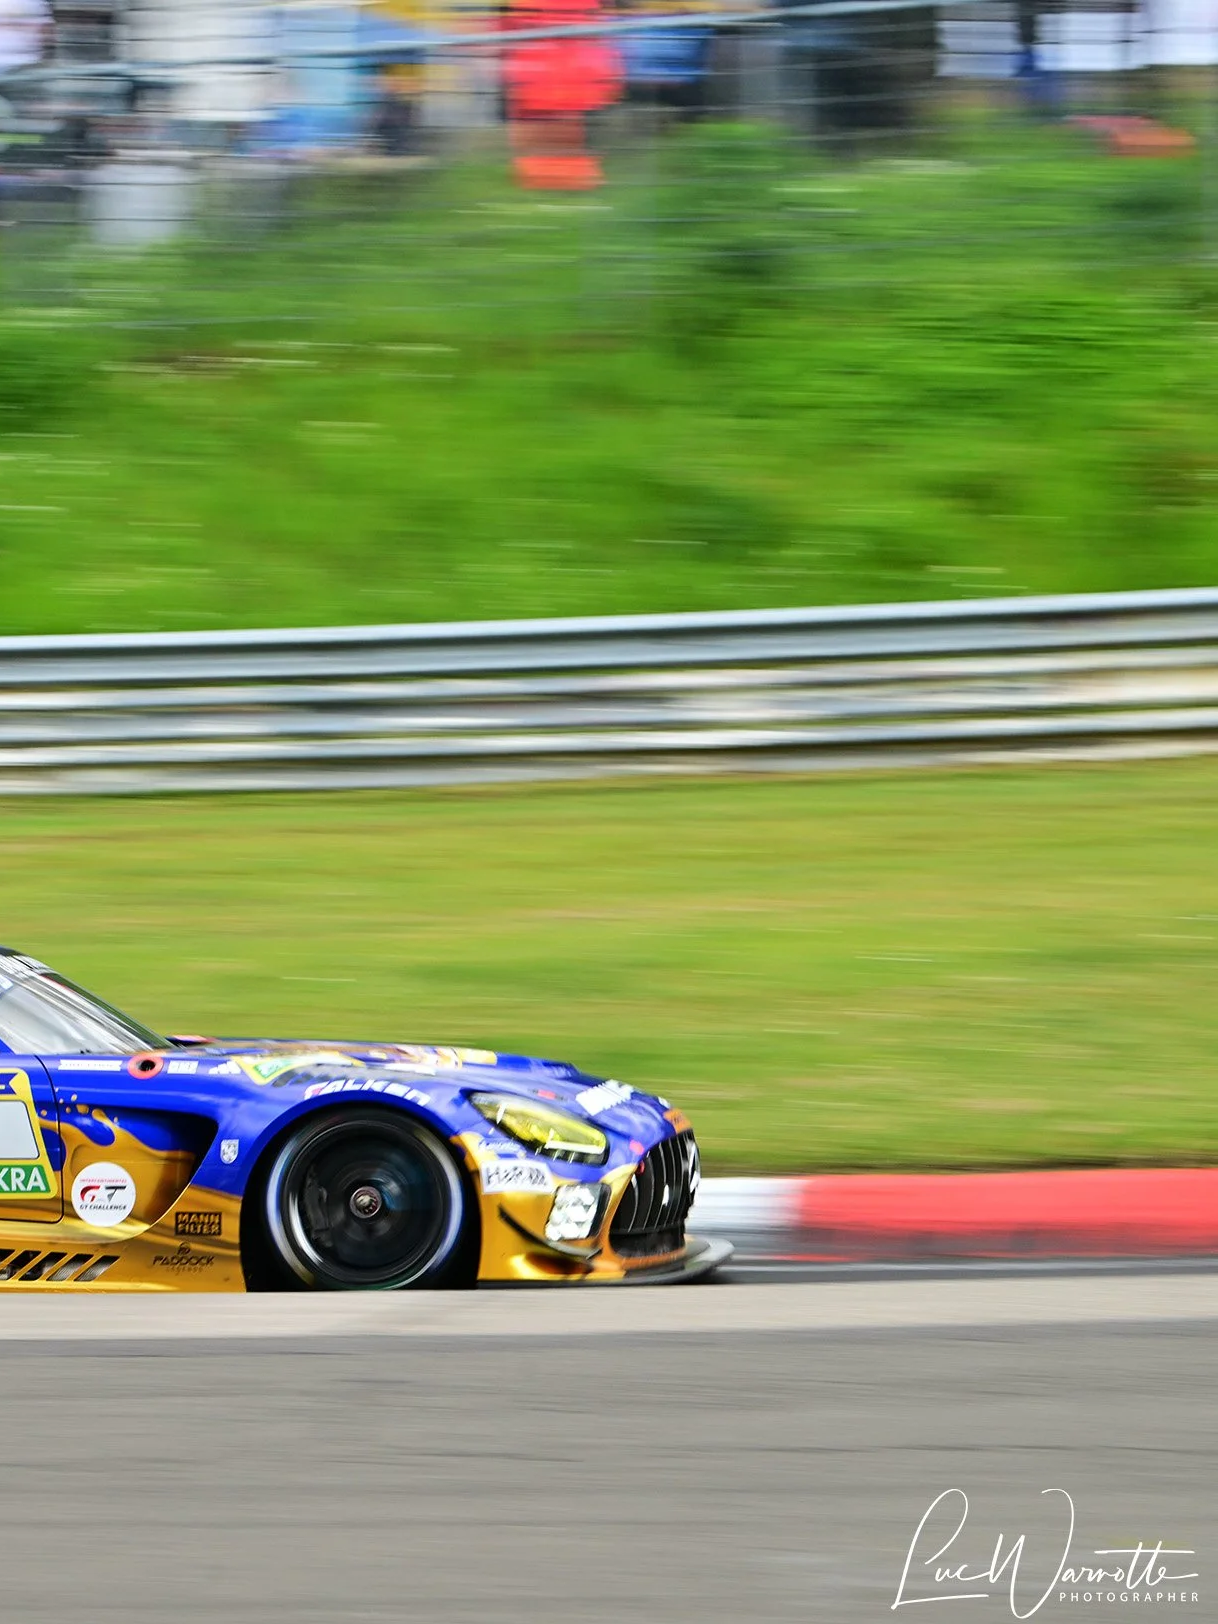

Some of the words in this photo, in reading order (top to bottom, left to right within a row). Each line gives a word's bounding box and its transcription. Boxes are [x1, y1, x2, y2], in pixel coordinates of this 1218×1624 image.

[304, 1079, 431, 1107] FALKEN
[178, 1213, 220, 1223] MANN
[178, 1224, 220, 1234] FILTER
